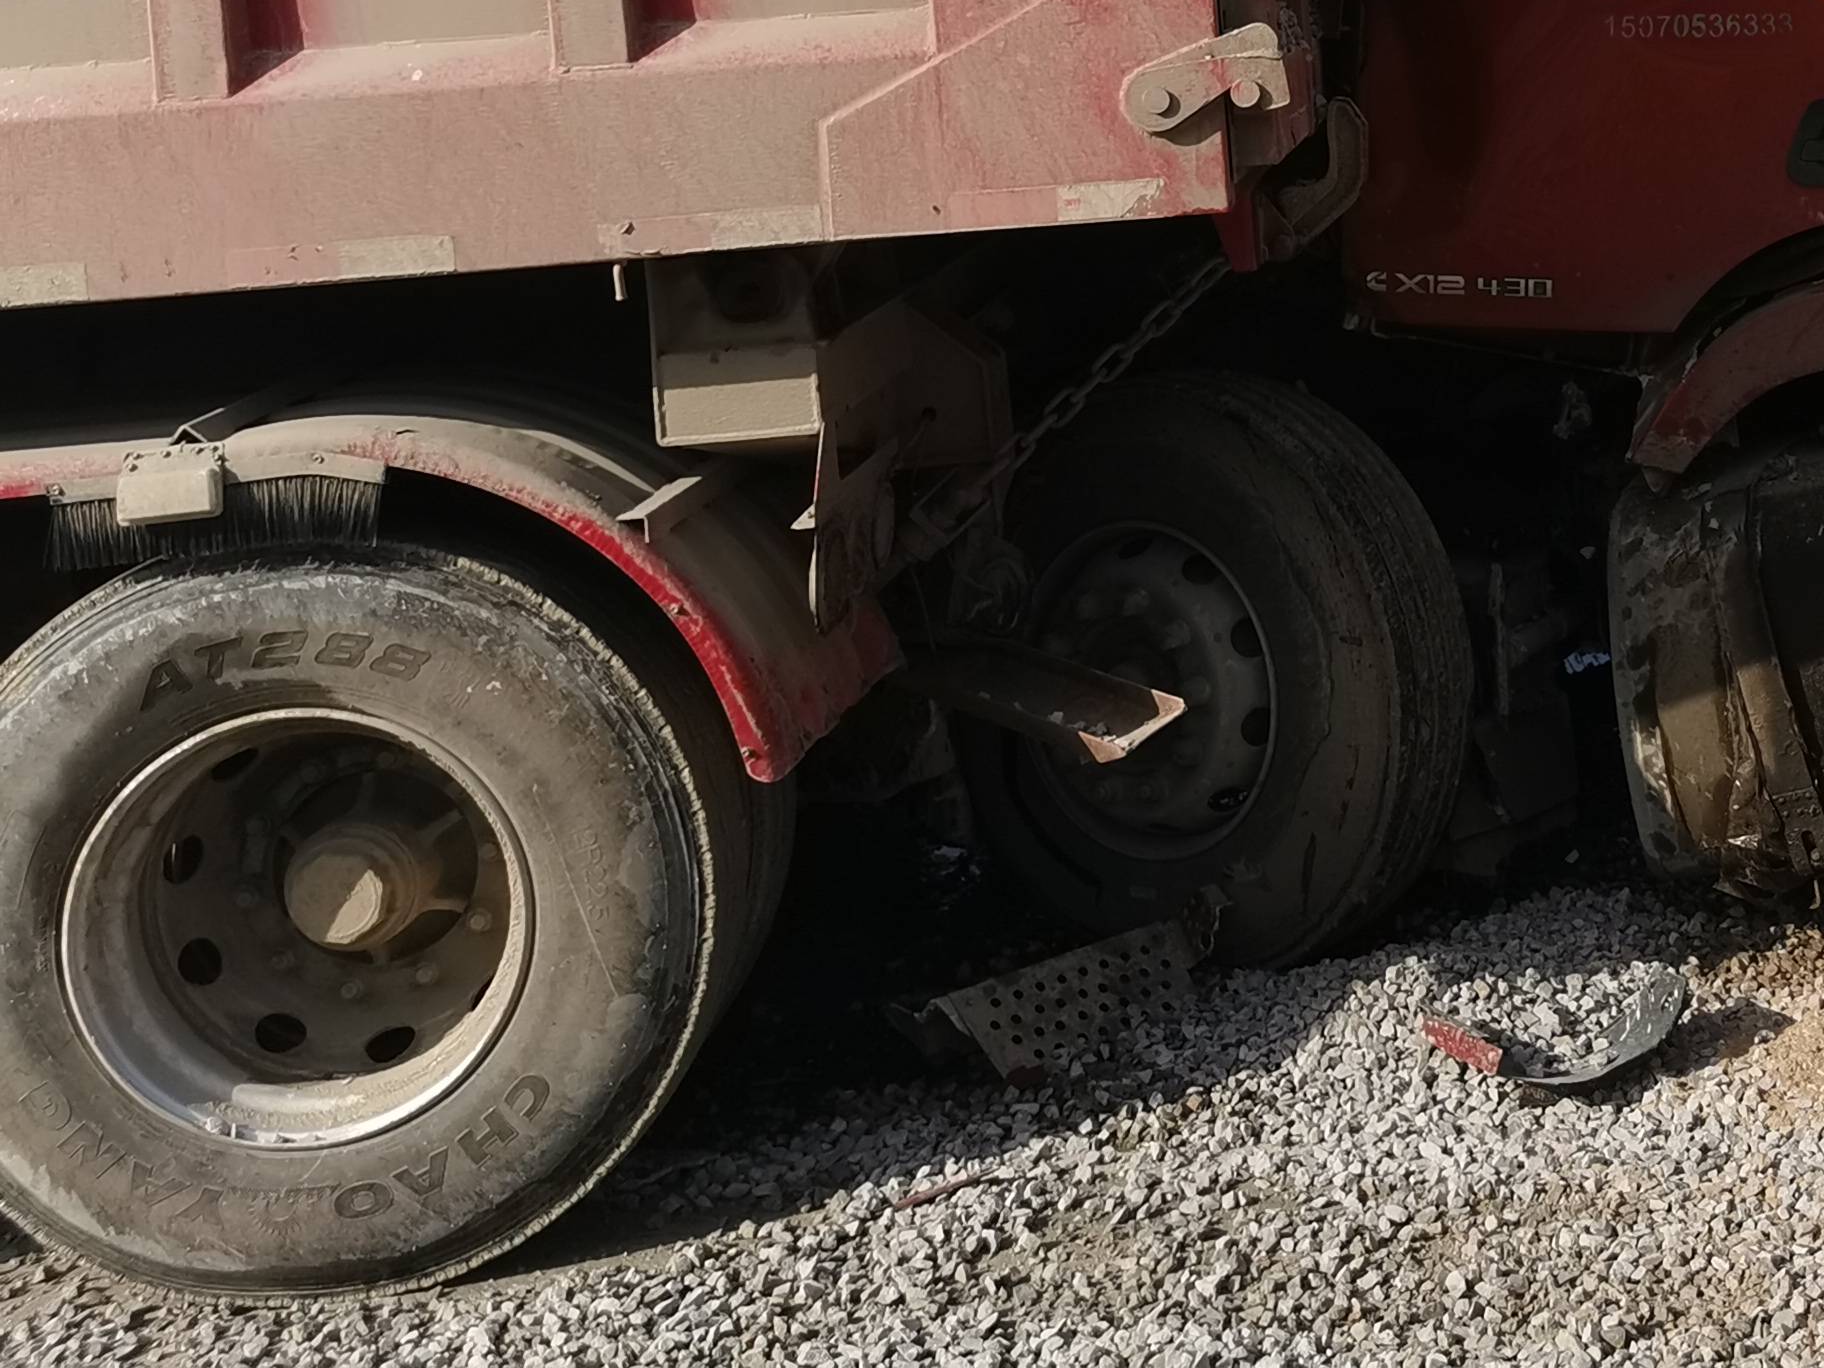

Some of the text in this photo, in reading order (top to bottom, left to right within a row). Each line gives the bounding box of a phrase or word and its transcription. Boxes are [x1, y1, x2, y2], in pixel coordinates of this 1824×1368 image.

[1605, 13, 1793, 38] 15070536333
[1477, 277, 1553, 298] 430
[140, 630, 432, 712] AT288
[332, 1073, 551, 1220] CHAO
